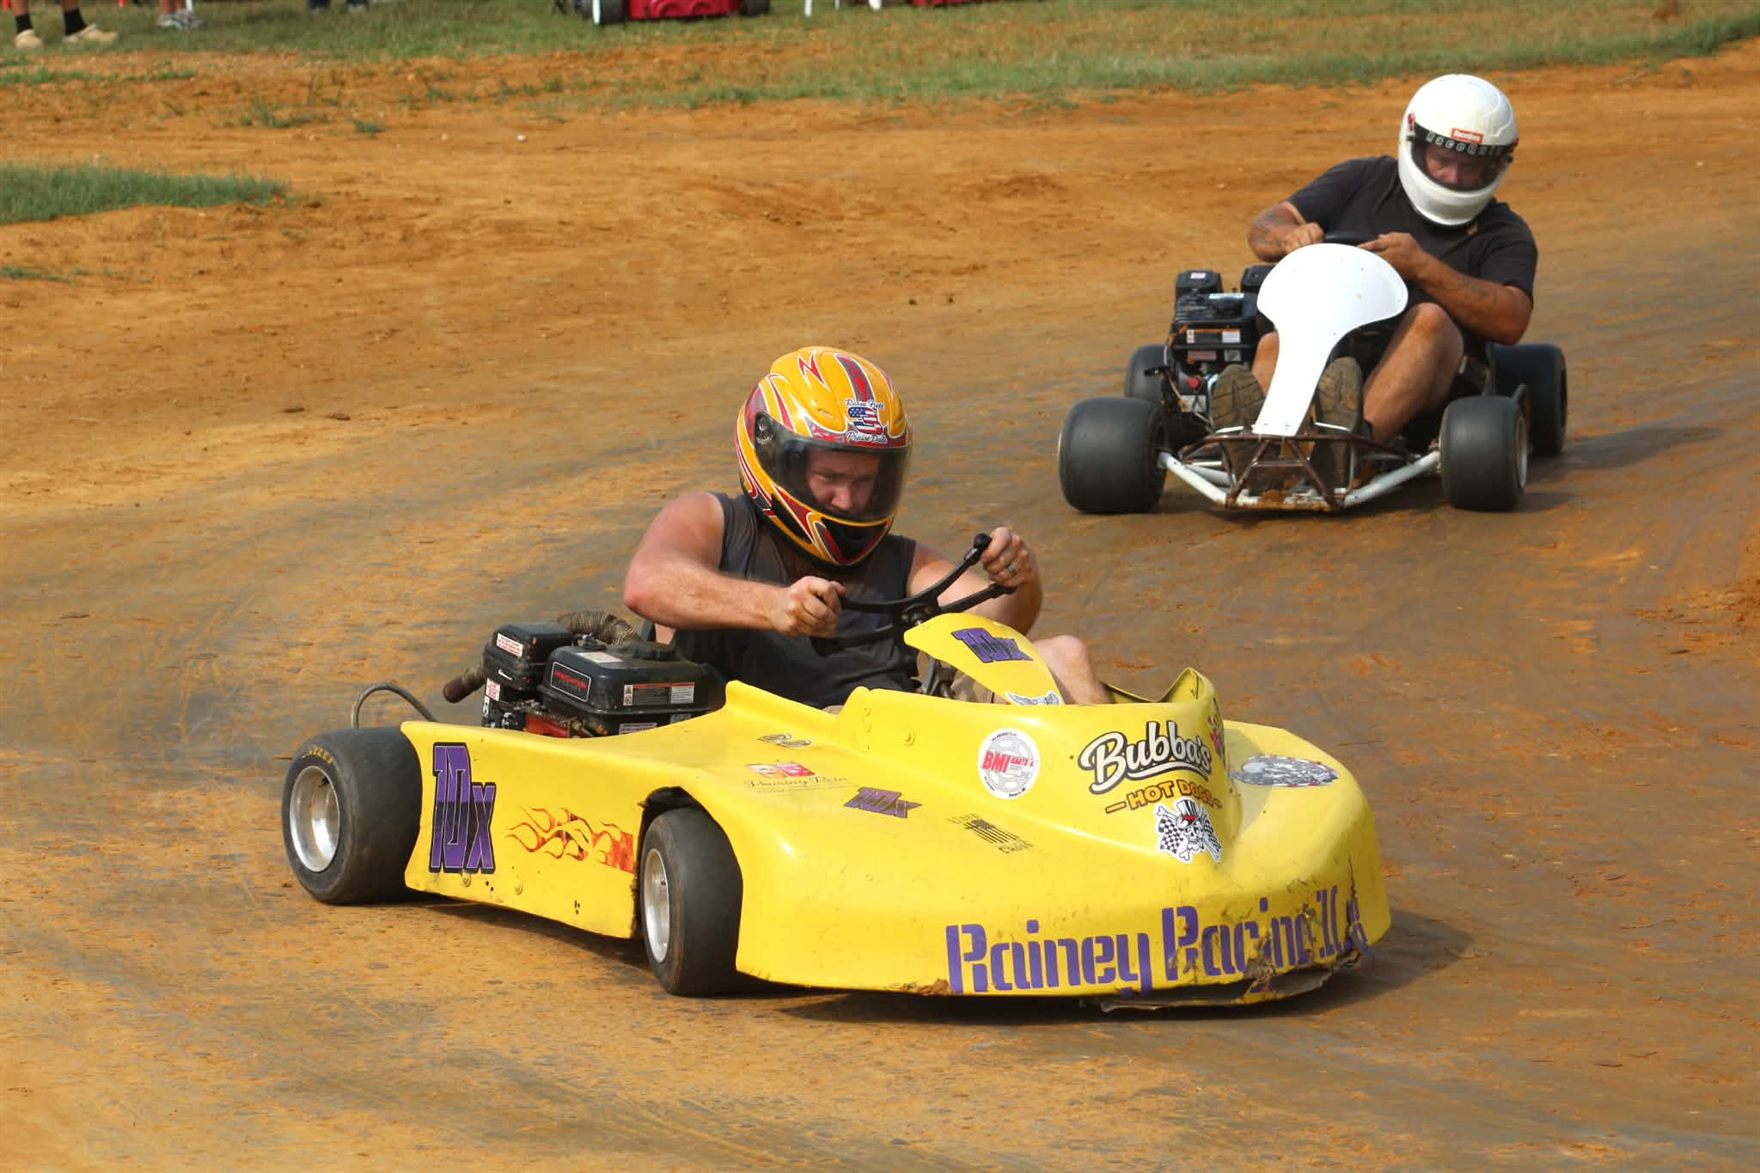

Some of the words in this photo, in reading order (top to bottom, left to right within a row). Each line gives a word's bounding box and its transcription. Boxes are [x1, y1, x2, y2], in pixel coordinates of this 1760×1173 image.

[982, 750, 1011, 774] BMI
[1078, 720, 1212, 795] Bubba's
[1126, 779, 1175, 810] HOT
[945, 919, 1152, 998] Rainey
